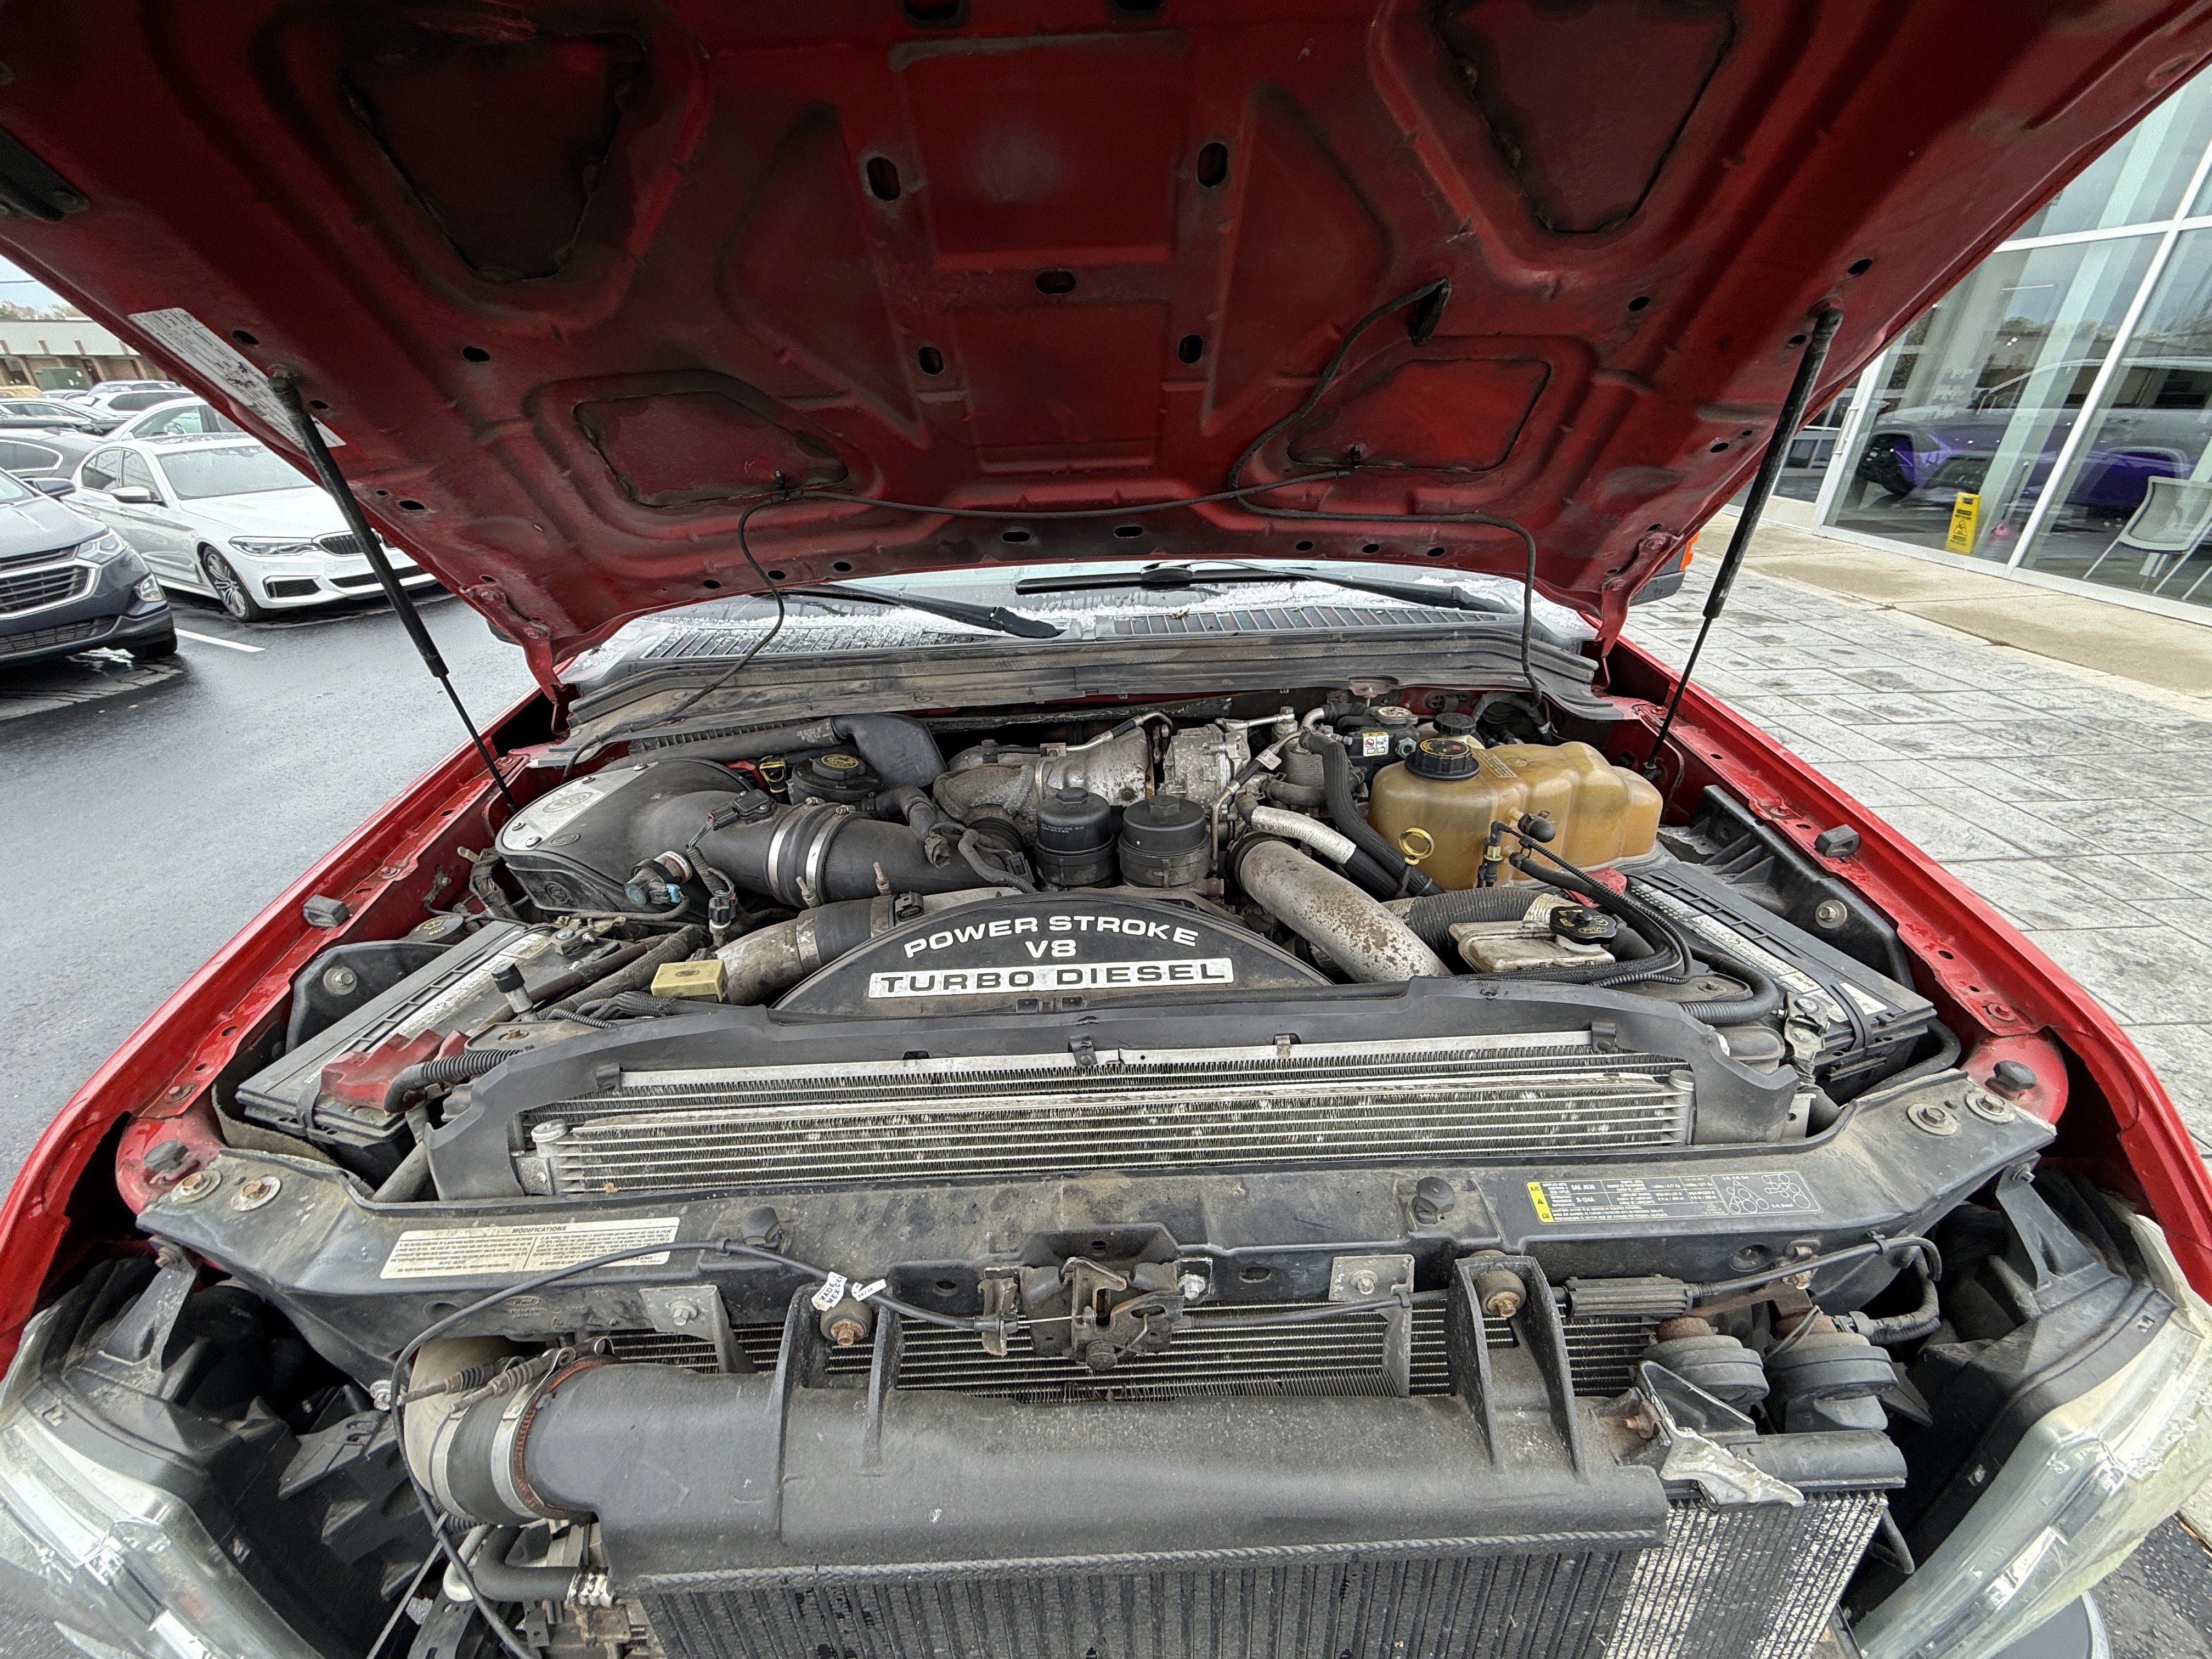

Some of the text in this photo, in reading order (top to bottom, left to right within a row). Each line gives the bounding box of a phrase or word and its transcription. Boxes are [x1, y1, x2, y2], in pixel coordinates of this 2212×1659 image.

[904, 916, 1199, 959] POWER STROKE
[1024, 939, 1077, 959] V8
[881, 961, 1226, 994] TURBO DIESEL
[511, 1226, 567, 1234] MODIFICATIONS
[819, 1282, 834, 1300] MADE
[827, 1276, 843, 1304] MEXCO
